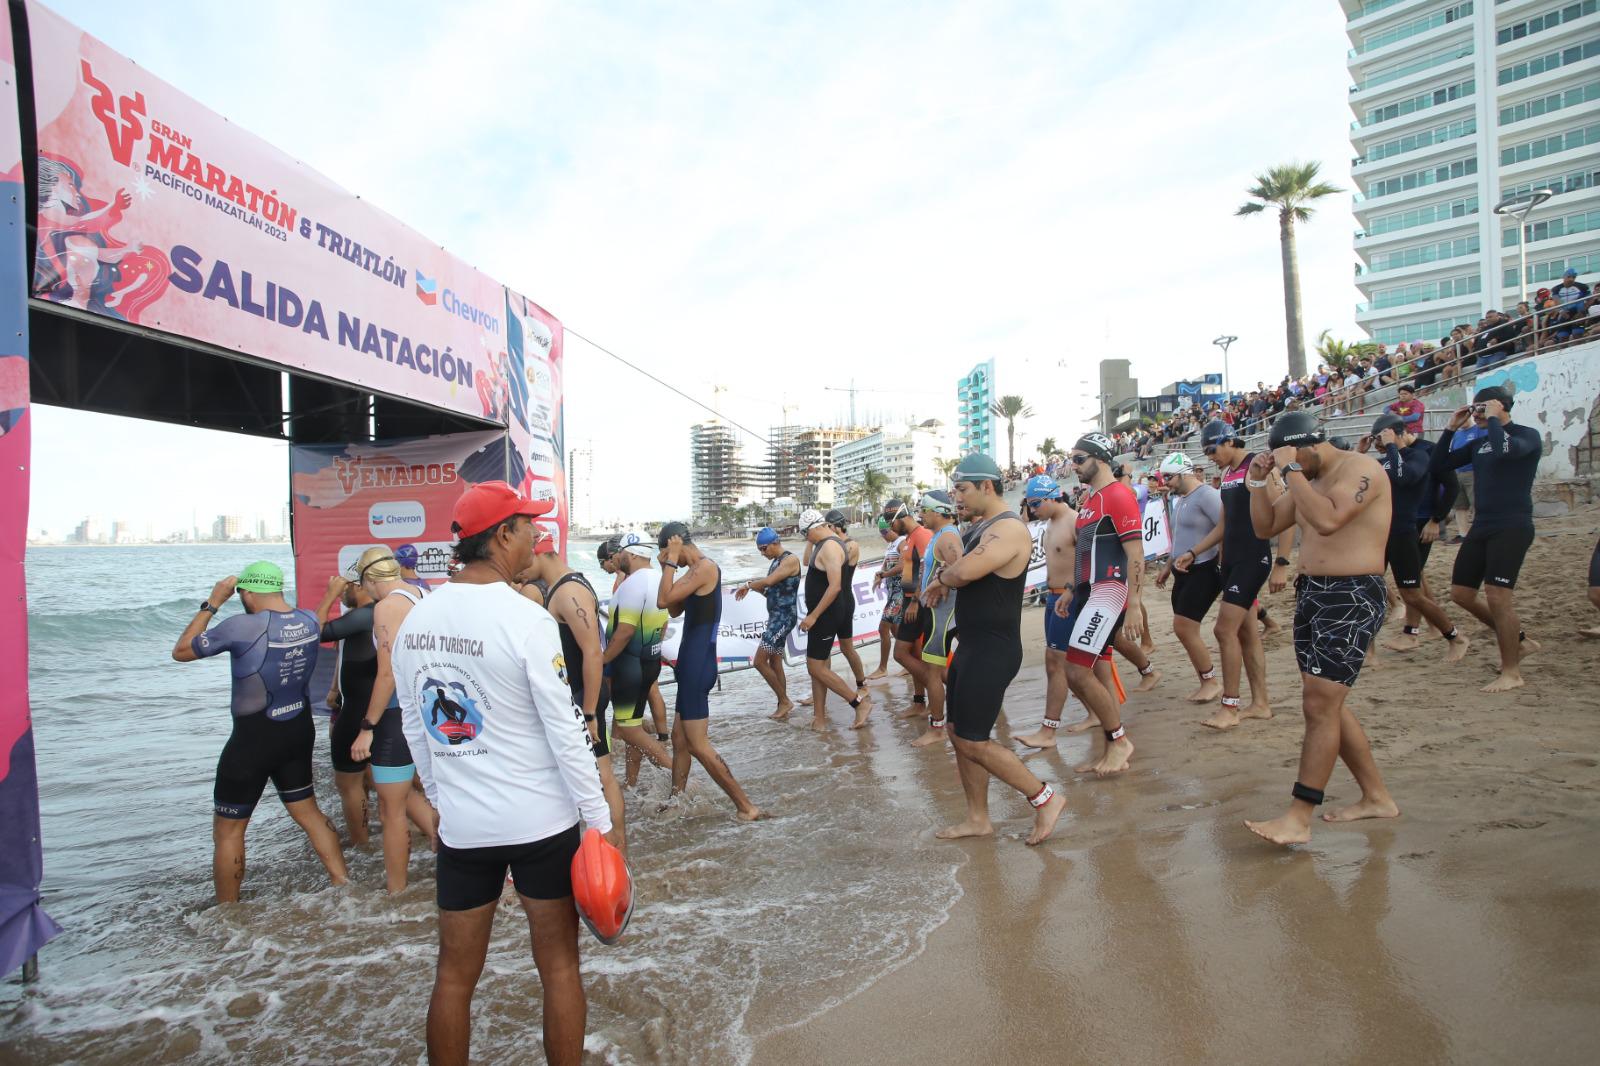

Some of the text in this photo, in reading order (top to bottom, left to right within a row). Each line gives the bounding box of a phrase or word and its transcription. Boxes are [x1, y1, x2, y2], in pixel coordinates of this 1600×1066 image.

[151, 119, 192, 150] GRAN
[145, 165, 287, 242] PACÍFICO MAZATLÁN 2023
[146, 133, 407, 289] MARATÓN & TRIATLÓN
[168, 244, 473, 388] SALIDA NATACIÓN
[442, 288, 499, 335] Chevron
[386, 514, 422, 525] Chevron
[1144, 516, 1162, 542] Jr.
[404, 631, 436, 652] POLICÍA
[439, 635, 485, 658] TURÍSTICA
[1077, 611, 1104, 646] Dauer
